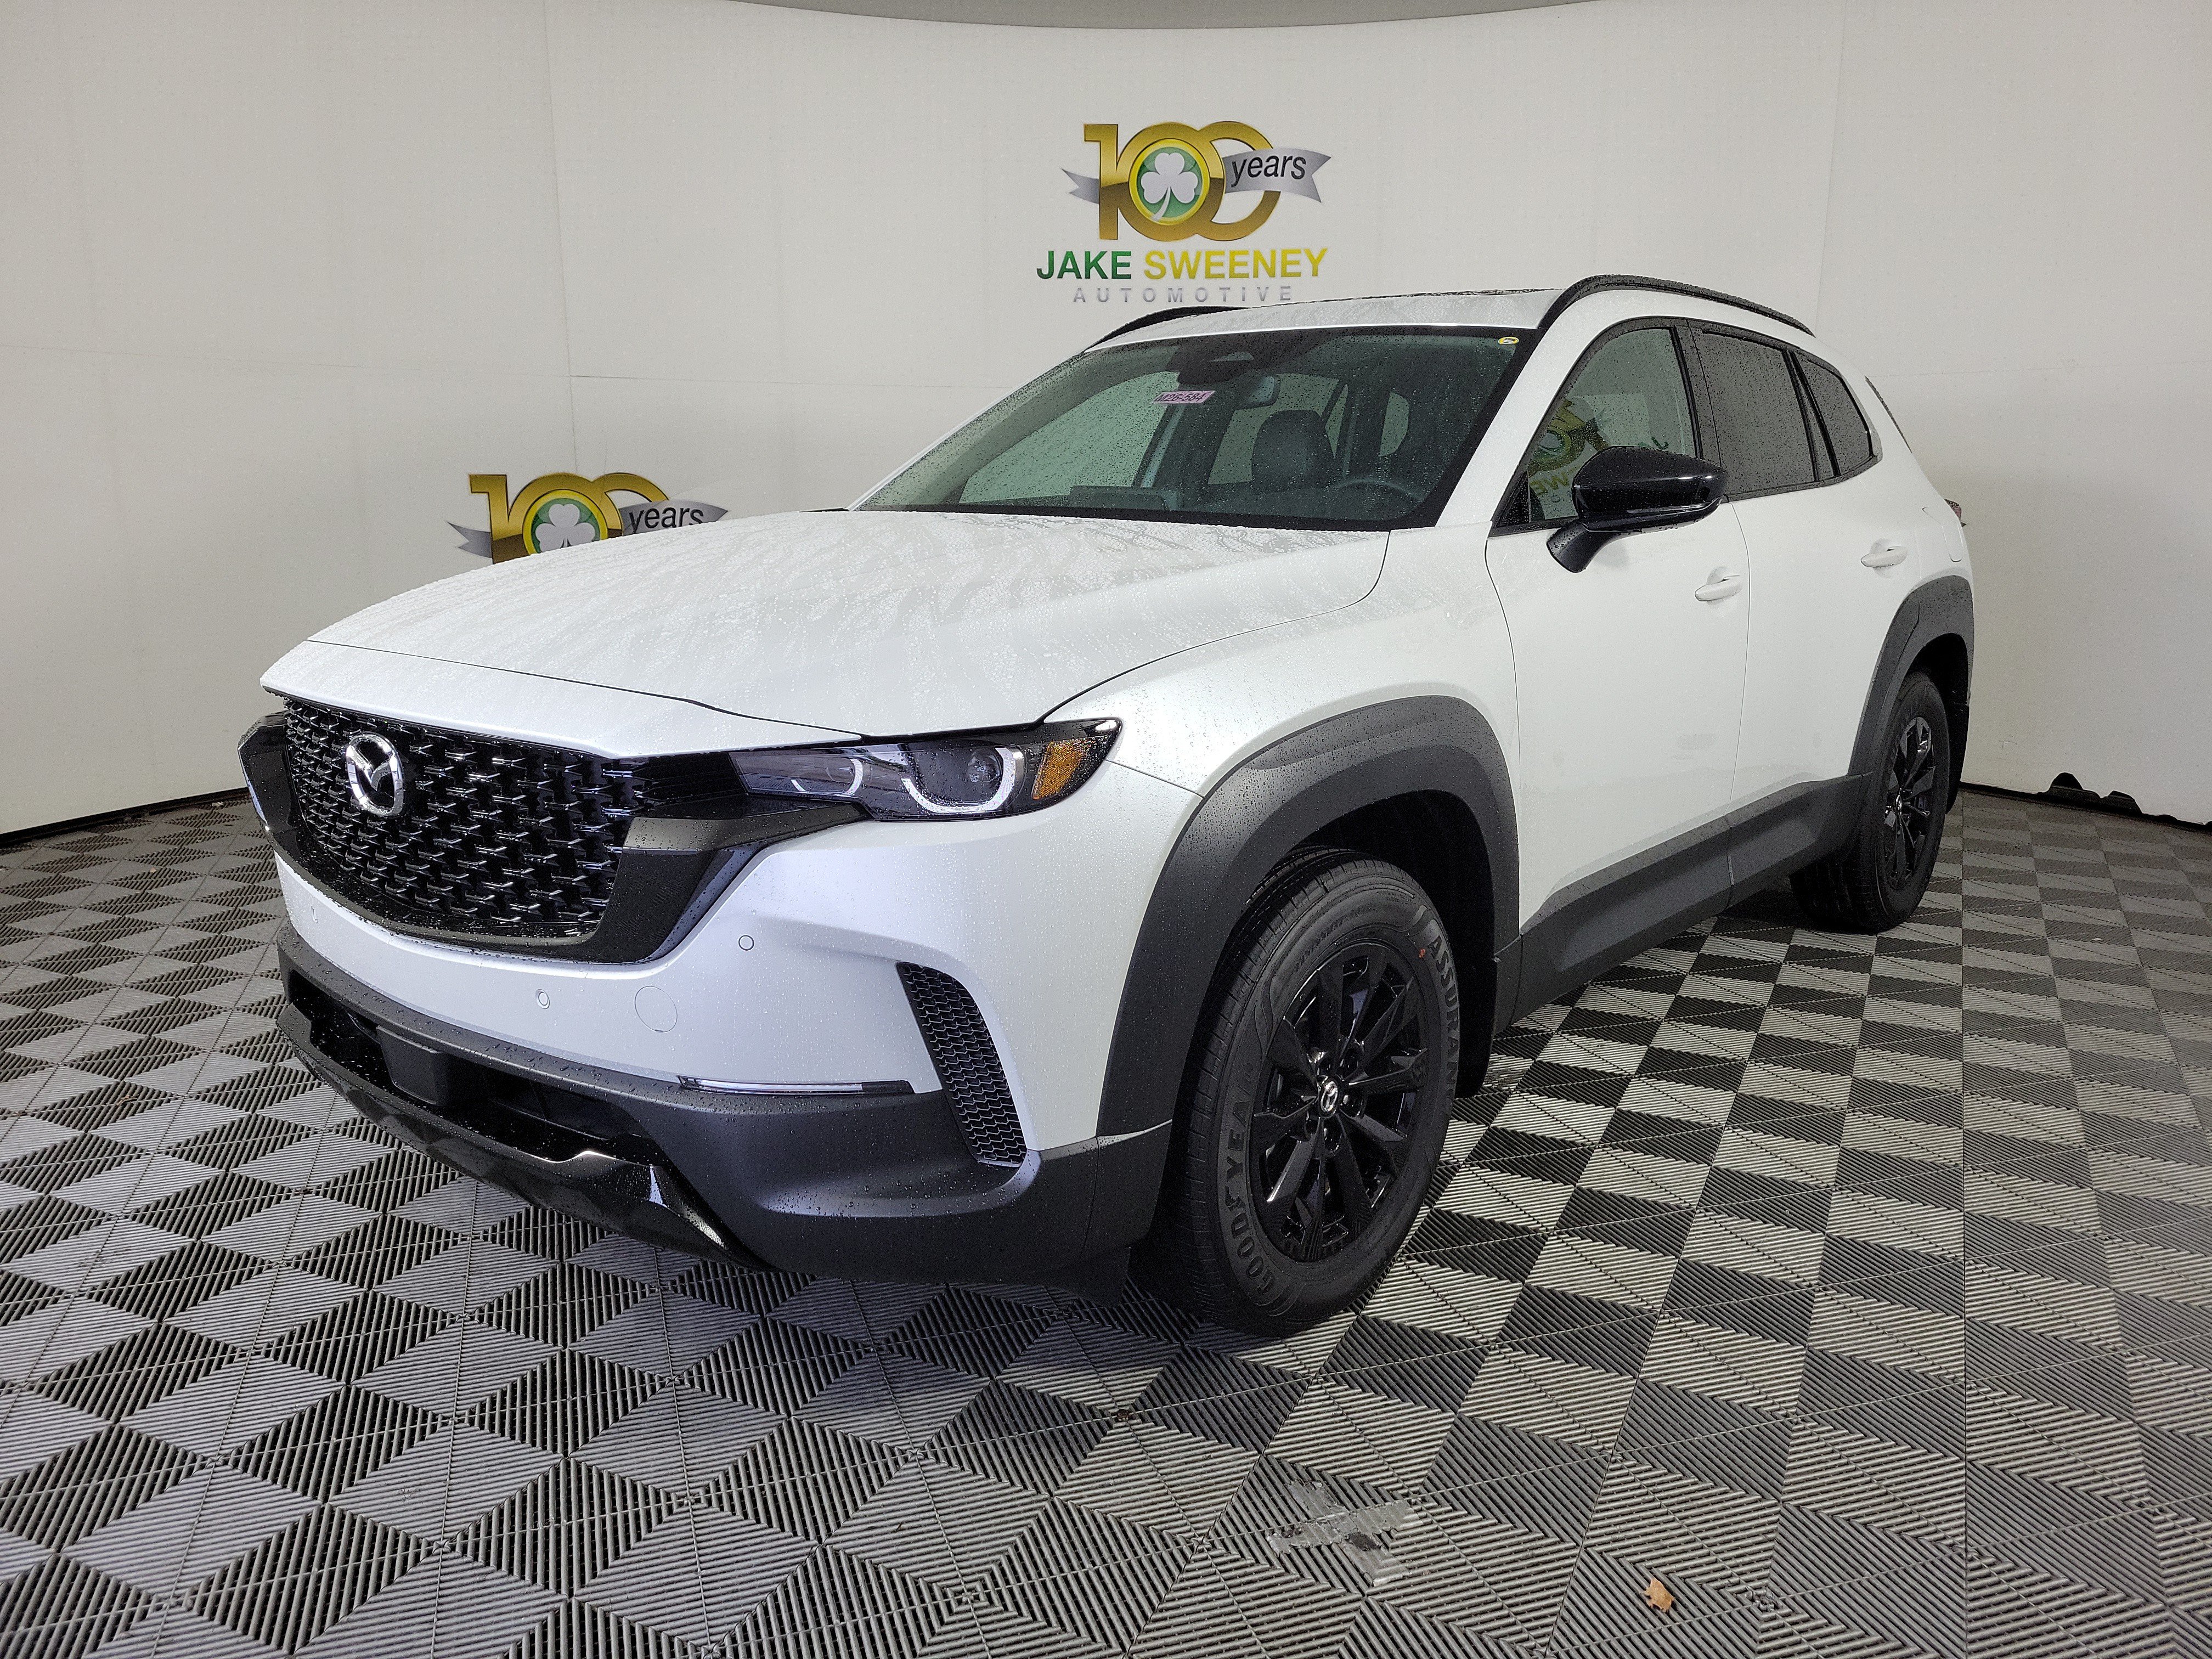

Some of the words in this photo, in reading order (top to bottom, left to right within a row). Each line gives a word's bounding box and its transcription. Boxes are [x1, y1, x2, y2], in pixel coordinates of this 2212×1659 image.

[1084, 120, 1282, 242] 100
[1231, 153, 1307, 187] years
[1036, 250, 1132, 280] JAKE
[1143, 247, 1328, 280] SWEENEY
[1073, 286, 1293, 303] AUTOMOTIVE
[1154, 392, 1206, 402] M26-584
[628, 506, 704, 534] years
[1224, 1062, 1275, 1295] GOODYEAR
